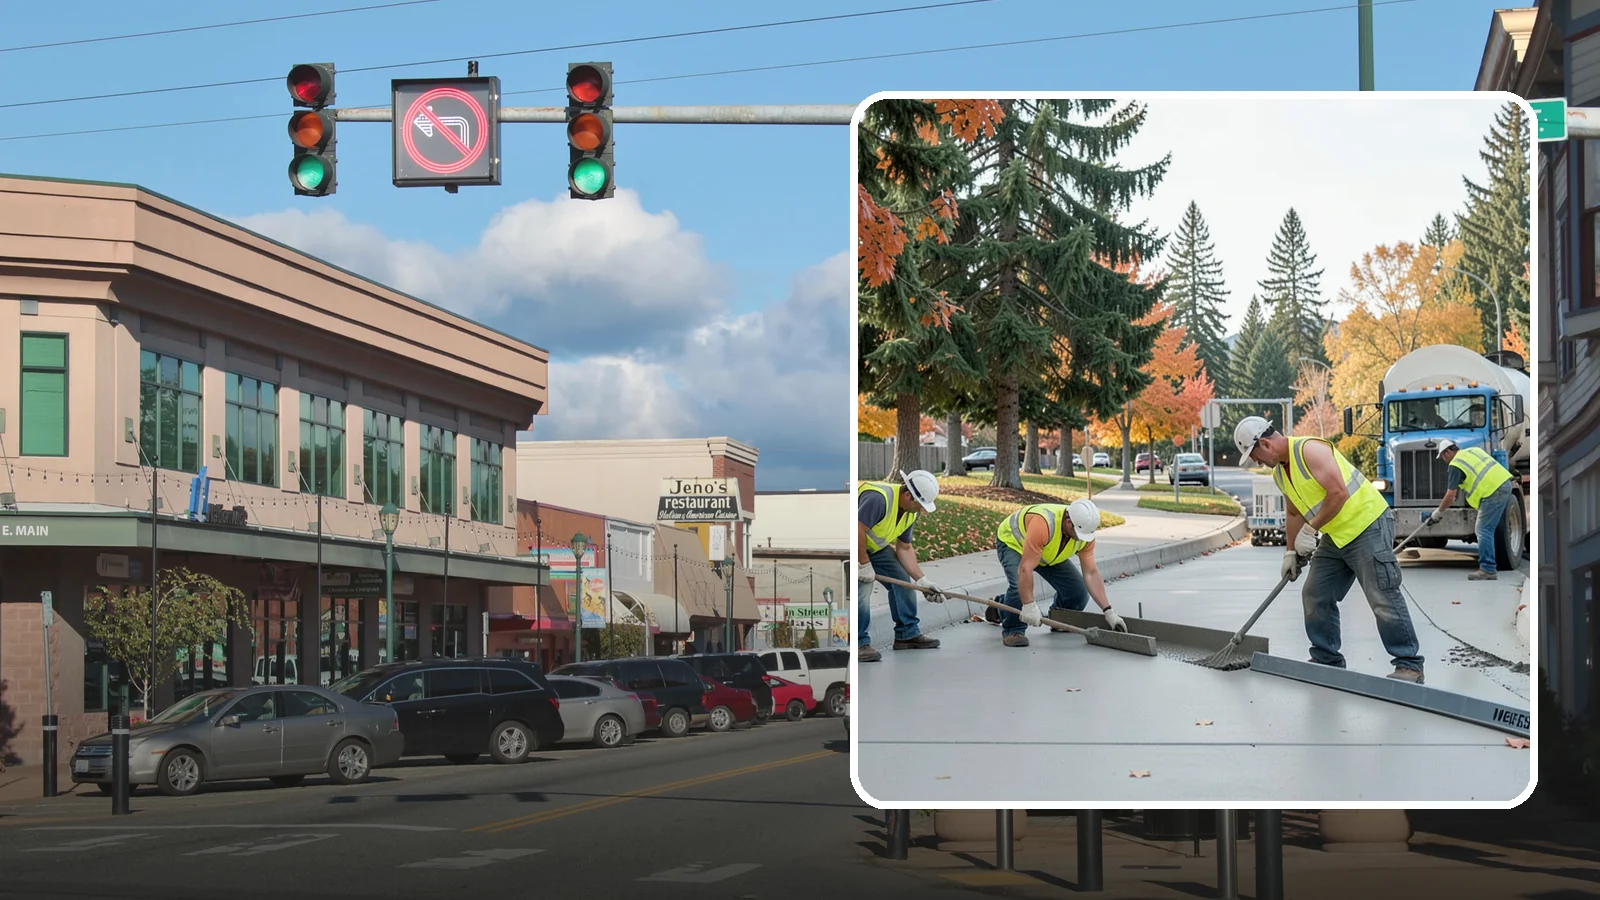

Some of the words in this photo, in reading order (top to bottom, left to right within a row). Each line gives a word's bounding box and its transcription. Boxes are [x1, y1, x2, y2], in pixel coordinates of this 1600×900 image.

[669, 480, 727, 495] Jeno's
[665, 496, 731, 509] restaurant
[658, 509, 681, 519] Italian
[685, 509, 715, 519] American
[715, 509, 738, 519] Cuisine
[2, 525, 13, 536] E.
[15, 525, 49, 536] MAIN
[797, 607, 829, 617] Street
[789, 619, 824, 627] lass
